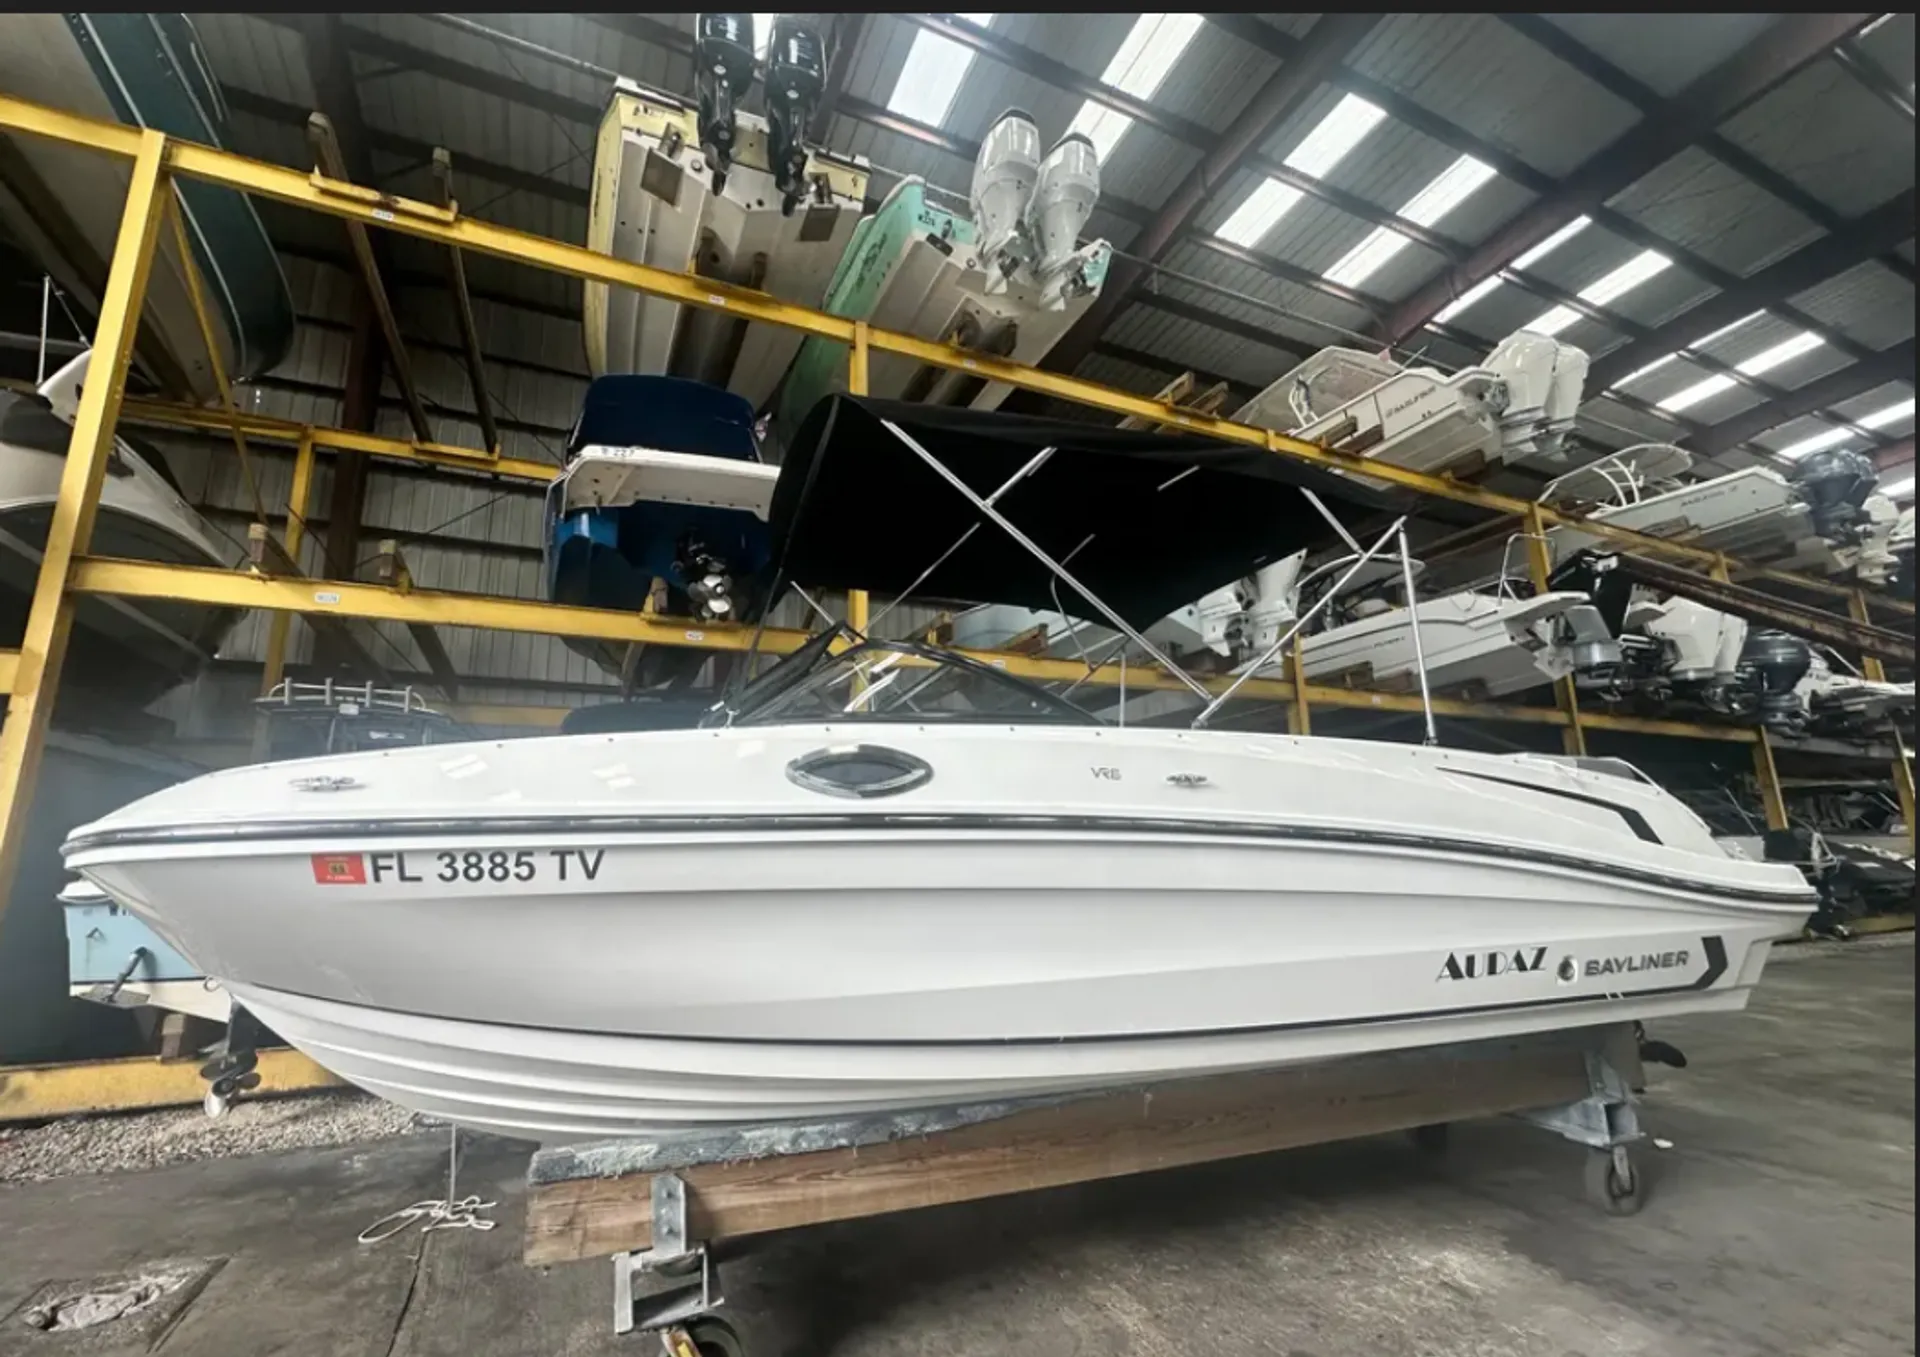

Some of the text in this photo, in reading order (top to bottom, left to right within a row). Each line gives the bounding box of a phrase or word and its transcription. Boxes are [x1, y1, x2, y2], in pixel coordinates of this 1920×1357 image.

[370, 852, 424, 883] FL
[436, 851, 537, 883] 3885
[551, 850, 606, 881] TV
[1435, 947, 1690, 982] AUDAZ BAYLINER
